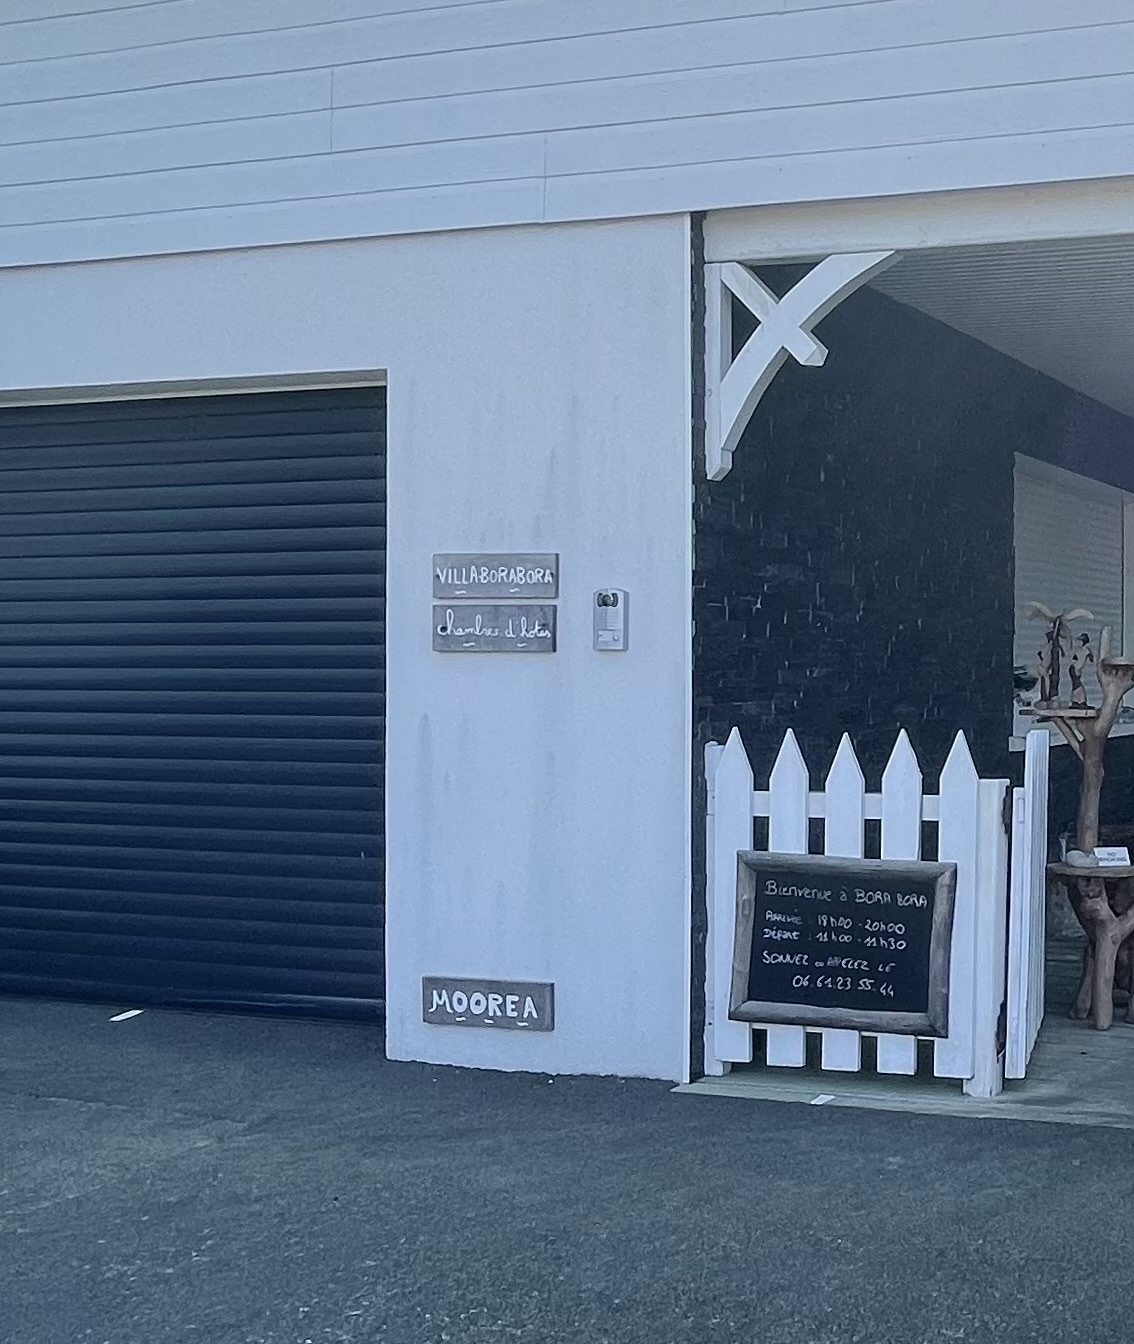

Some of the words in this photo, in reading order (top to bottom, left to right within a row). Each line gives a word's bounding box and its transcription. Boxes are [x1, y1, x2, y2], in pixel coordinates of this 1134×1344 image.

[764, 879, 833, 902] Bienvenue
[839, 885, 848, 902] à
[854, 888, 891, 905] BORA
[896, 892, 928, 908] BORA
[428, 989, 539, 1019] MOOREA
